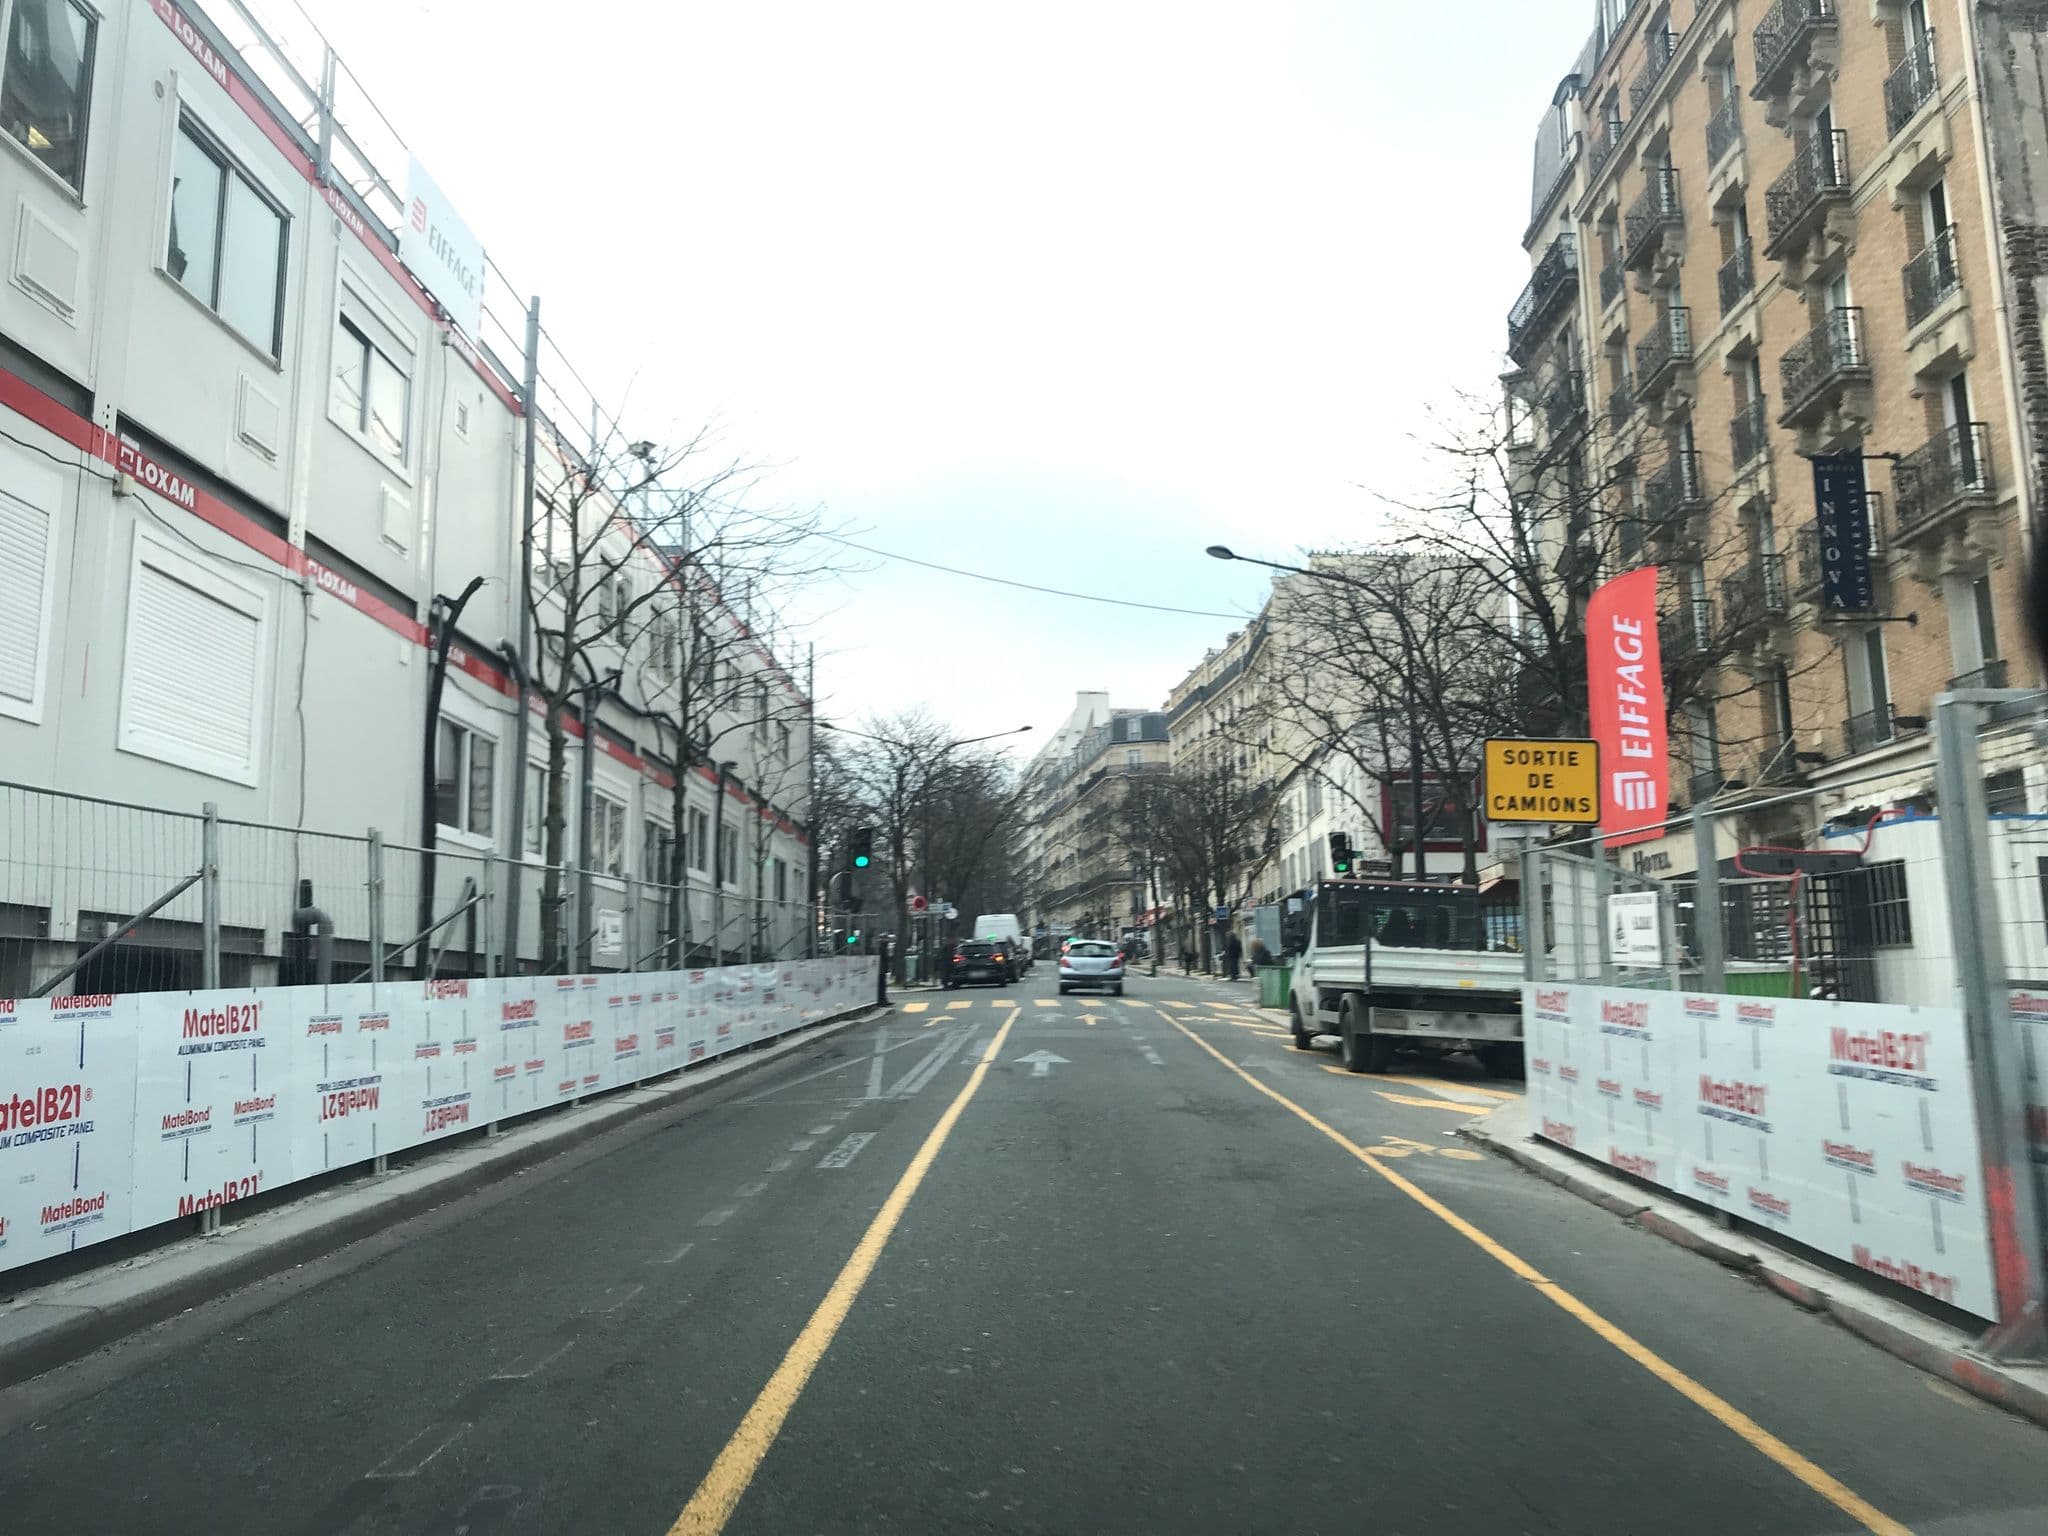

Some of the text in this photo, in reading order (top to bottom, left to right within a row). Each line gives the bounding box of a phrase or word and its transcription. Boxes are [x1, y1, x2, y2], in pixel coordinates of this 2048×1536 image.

[174, 11, 226, 85] LOXAM
[428, 223, 475, 298] EIFFAGE
[136, 455, 195, 508] LOXAM
[1821, 478, 1846, 608] INNOVA
[317, 565, 357, 603] LOXAM
[1612, 614, 1654, 759] EIFFAGE
[1503, 749, 1580, 767] SORTIE
[1528, 773, 1555, 790] DE
[1493, 795, 1592, 813] CAMIONS
[13, 1125, 67, 1147] COMPOSITE
[68, 1120, 95, 1136] PANEL
[40, 1190, 105, 1226] MatelBond
